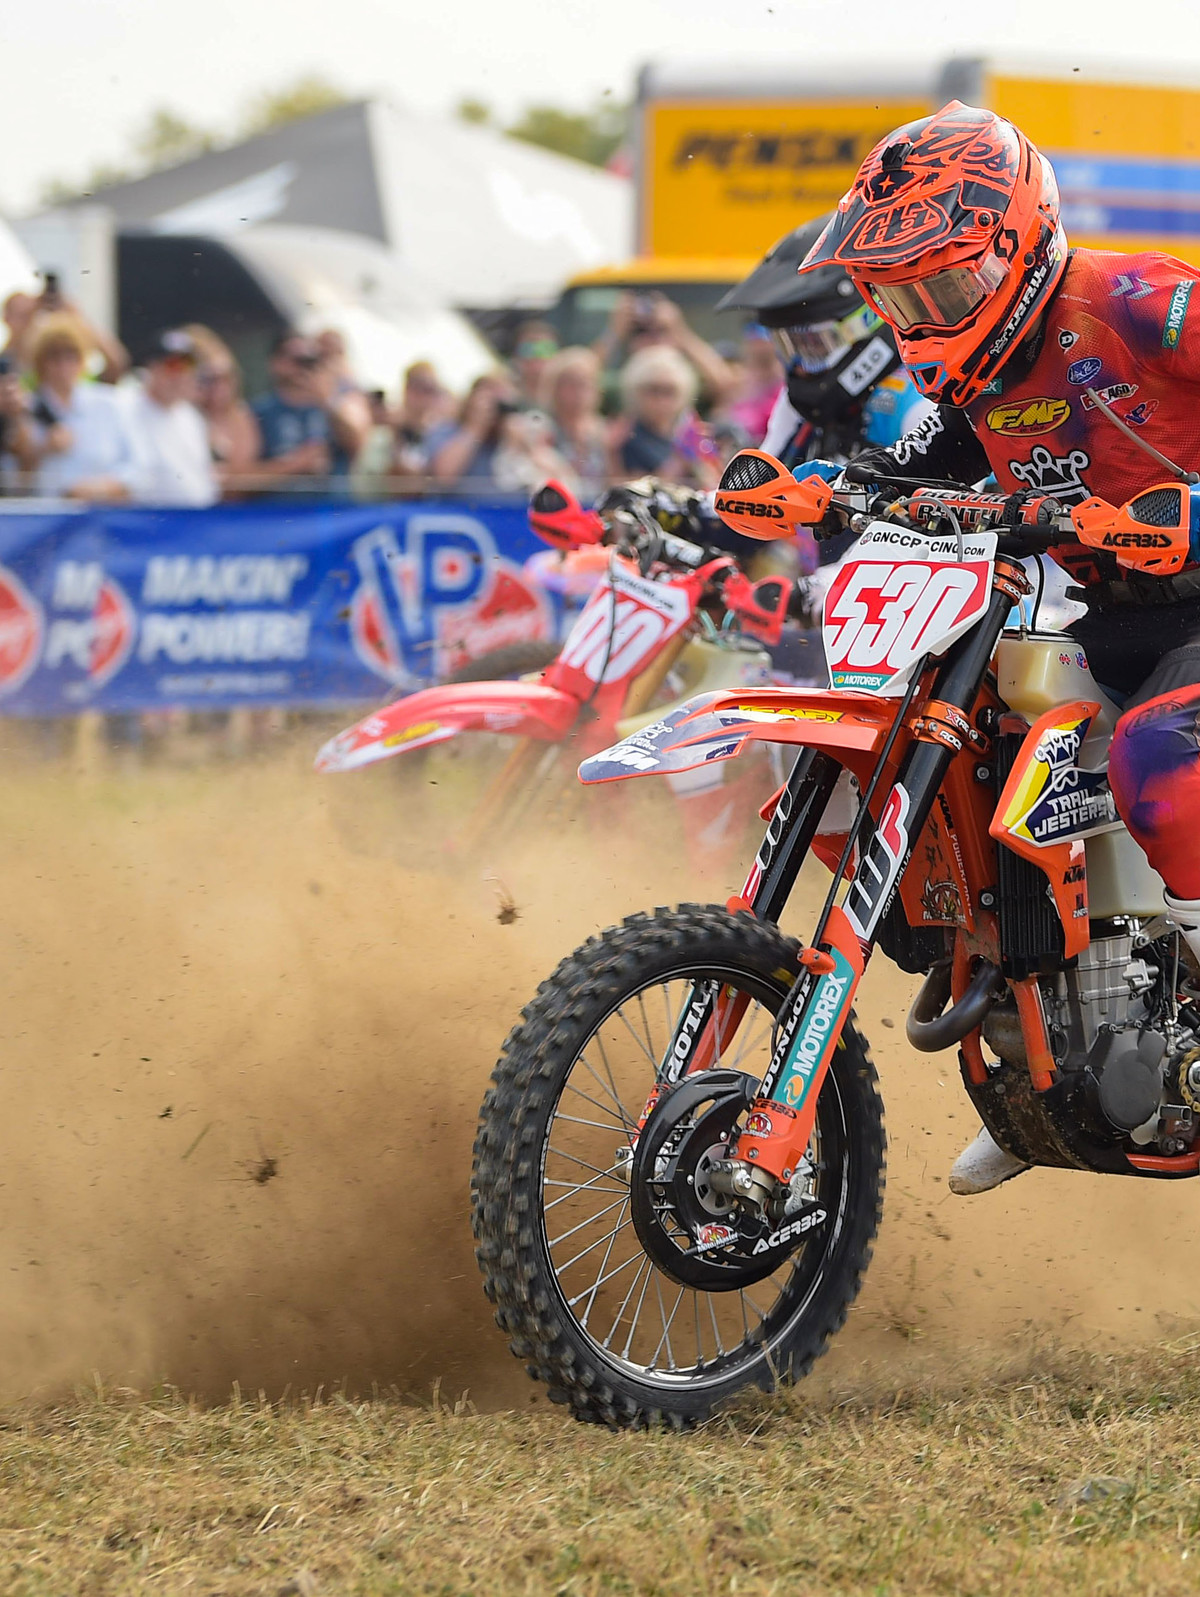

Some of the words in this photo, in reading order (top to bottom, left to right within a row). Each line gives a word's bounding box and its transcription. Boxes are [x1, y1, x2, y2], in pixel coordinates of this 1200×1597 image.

[1167, 280, 1194, 328] MOTORE
[990, 399, 1066, 430] FMF
[714, 498, 785, 519] ACERBIS
[1102, 531, 1173, 548] ACERBIS
[354, 514, 498, 690] VP
[823, 563, 979, 670] 530
[844, 673, 883, 688] MOTOREX
[1034, 800, 1108, 838] JESTERS
[1046, 788, 1095, 815] TRAIL
[1063, 864, 1087, 885] KTM
[667, 980, 721, 1083] NLOP
[761, 973, 813, 1099] DUNLOP
[792, 972, 848, 1077] MOTOREX
[752, 1206, 829, 1256] ACERBIS
